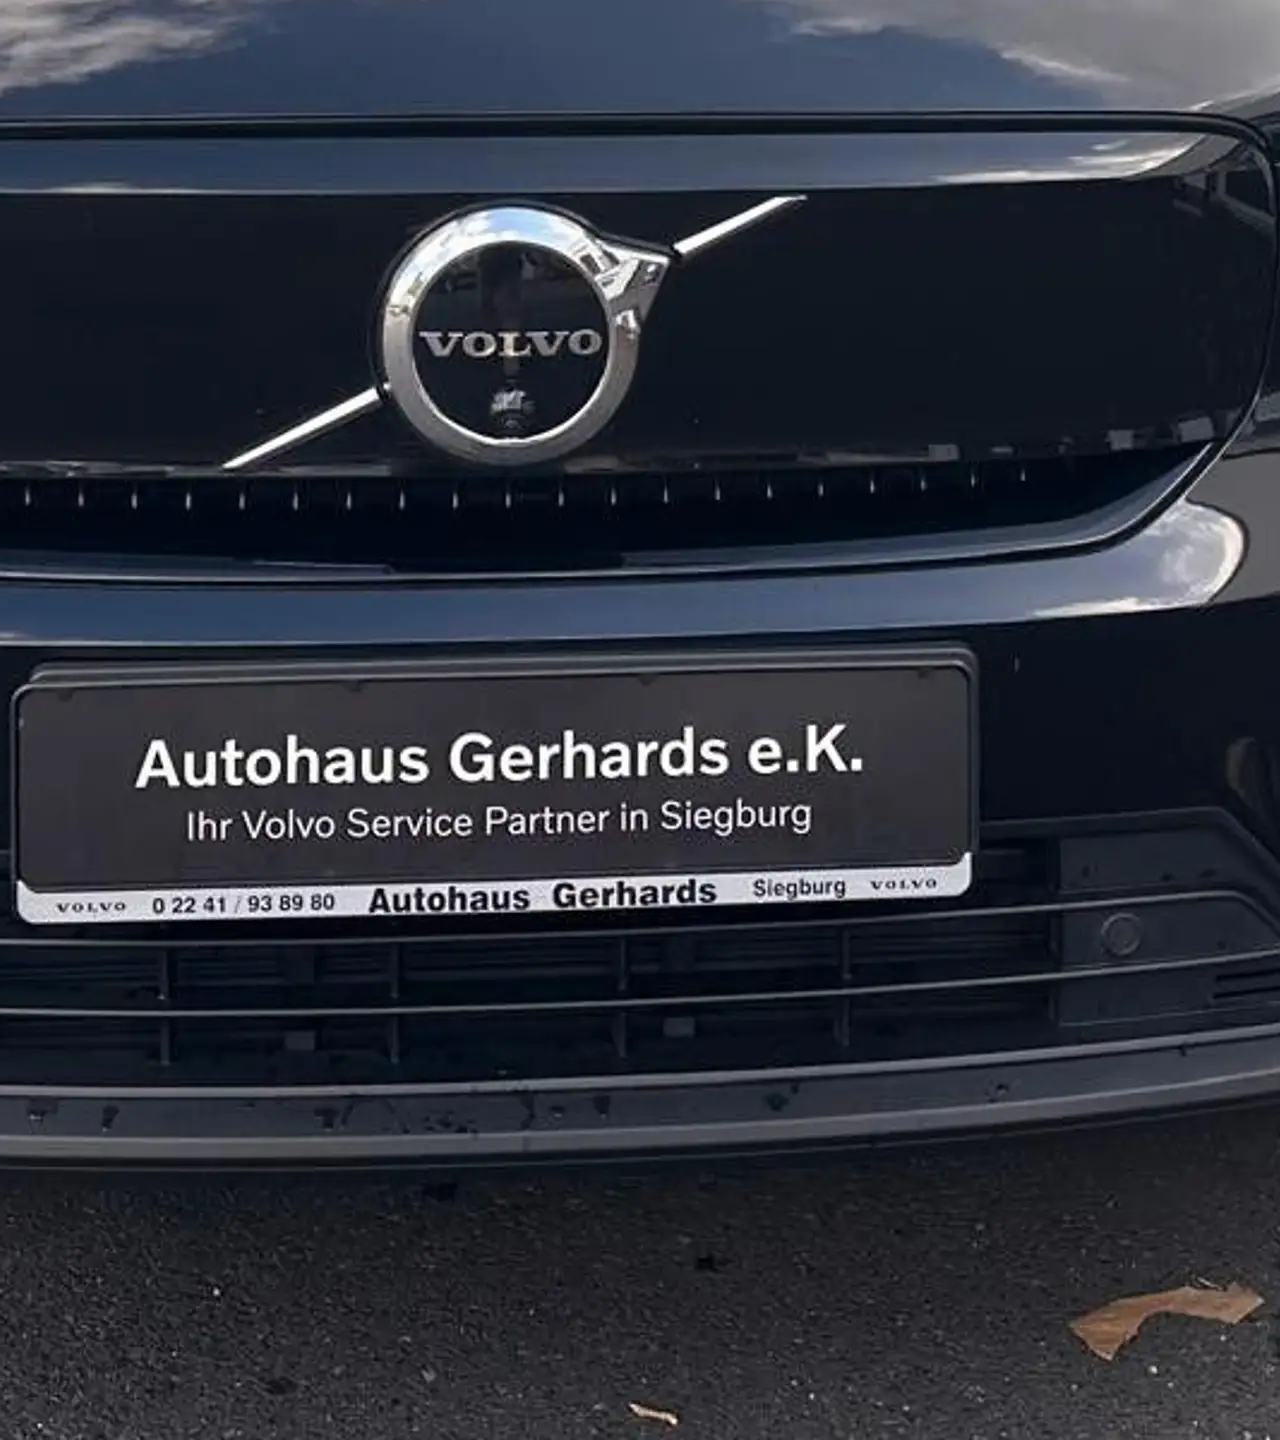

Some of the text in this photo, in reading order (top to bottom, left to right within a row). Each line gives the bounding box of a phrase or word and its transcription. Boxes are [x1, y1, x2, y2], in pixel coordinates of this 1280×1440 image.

[419, 328, 602, 358] VOLVO
[135, 723, 863, 788] Autohaus Gerhards e.K.
[188, 797, 812, 841] Ihr Volvo Service Partner in Siegburg
[56, 902, 127, 913] VOLVO
[152, 897, 166, 915] 0
[171, 896, 197, 914] 22
[203, 896, 226, 913] 41
[247, 894, 273, 913] 93
[278, 894, 304, 912] 89
[310, 893, 336, 911] 80
[370, 886, 531, 912] Autohaus
[552, 879, 717, 908] Gerhards
[753, 878, 846, 899] Siegburg
[870, 878, 937, 891] VOLVO
